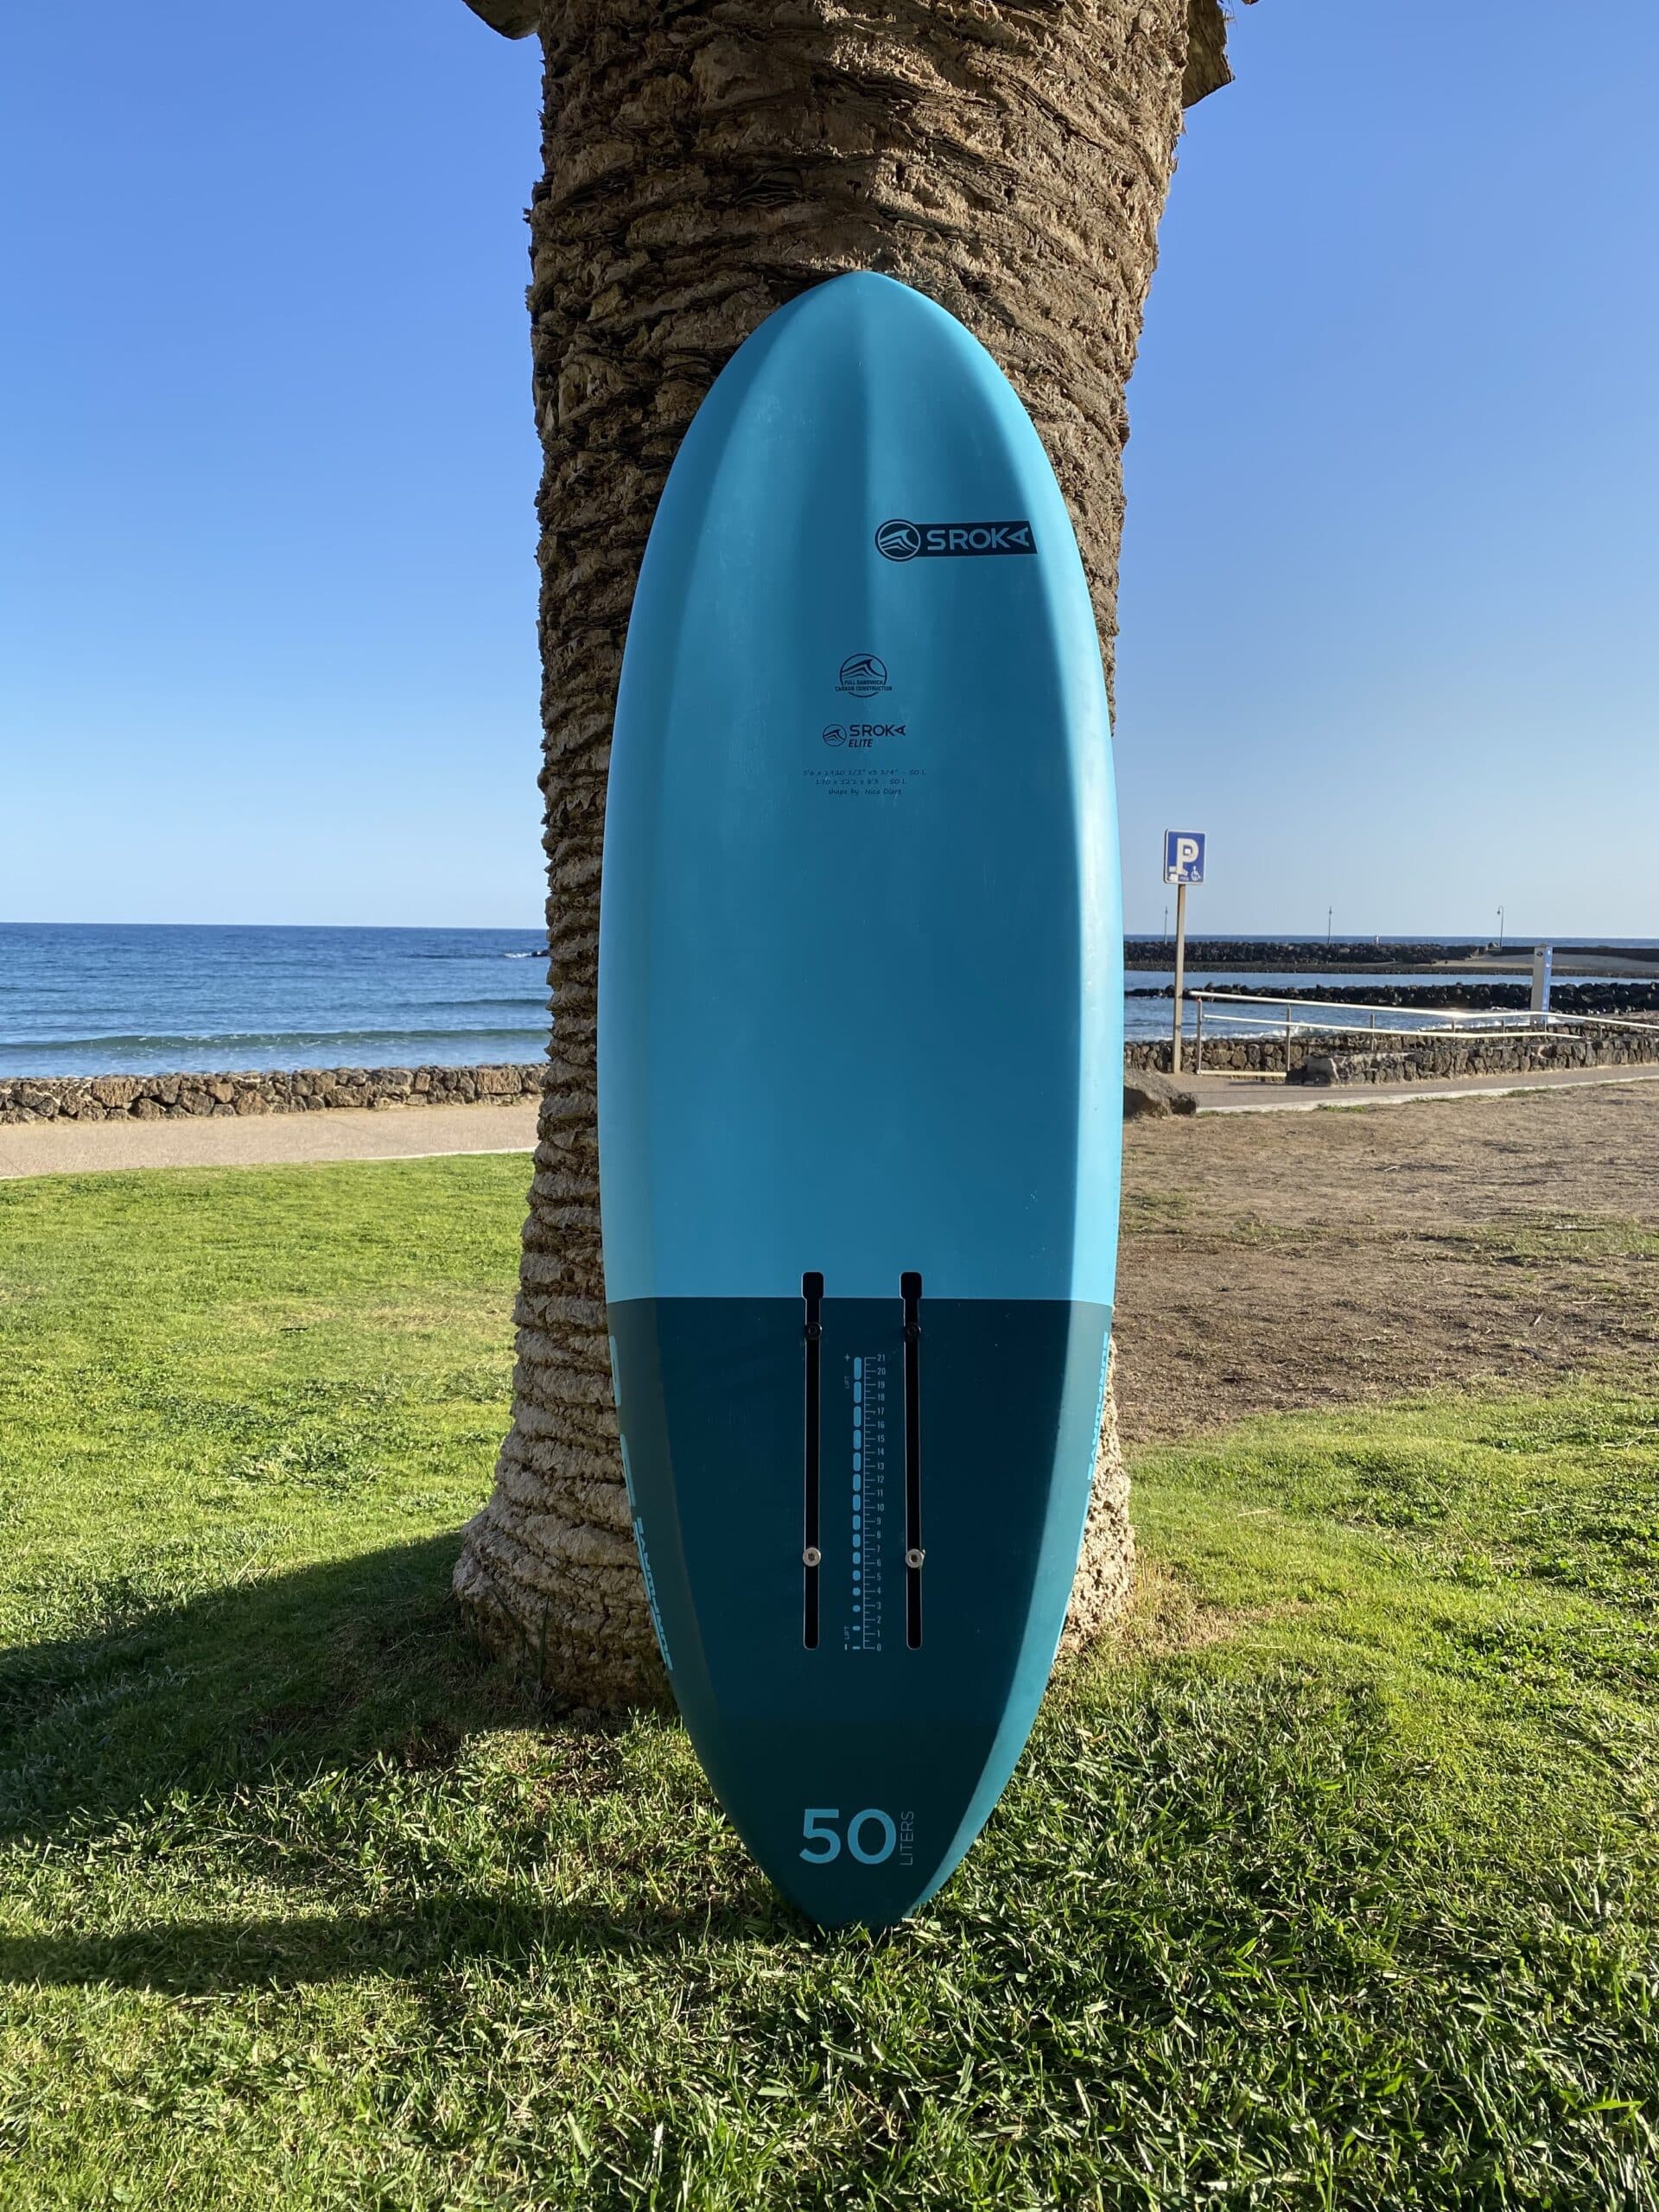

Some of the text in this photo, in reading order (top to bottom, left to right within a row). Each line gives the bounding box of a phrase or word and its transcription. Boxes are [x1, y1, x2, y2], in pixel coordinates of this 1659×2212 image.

[926, 527, 1030, 550] SROKA
[849, 724, 906, 736] SROKA
[849, 739, 874, 747] ELITE
[1177, 837, 1199, 874] P
[877, 1475, 885, 1484] 12
[799, 1808, 897, 1865] 50
[899, 1811, 914, 1866] LITERS
